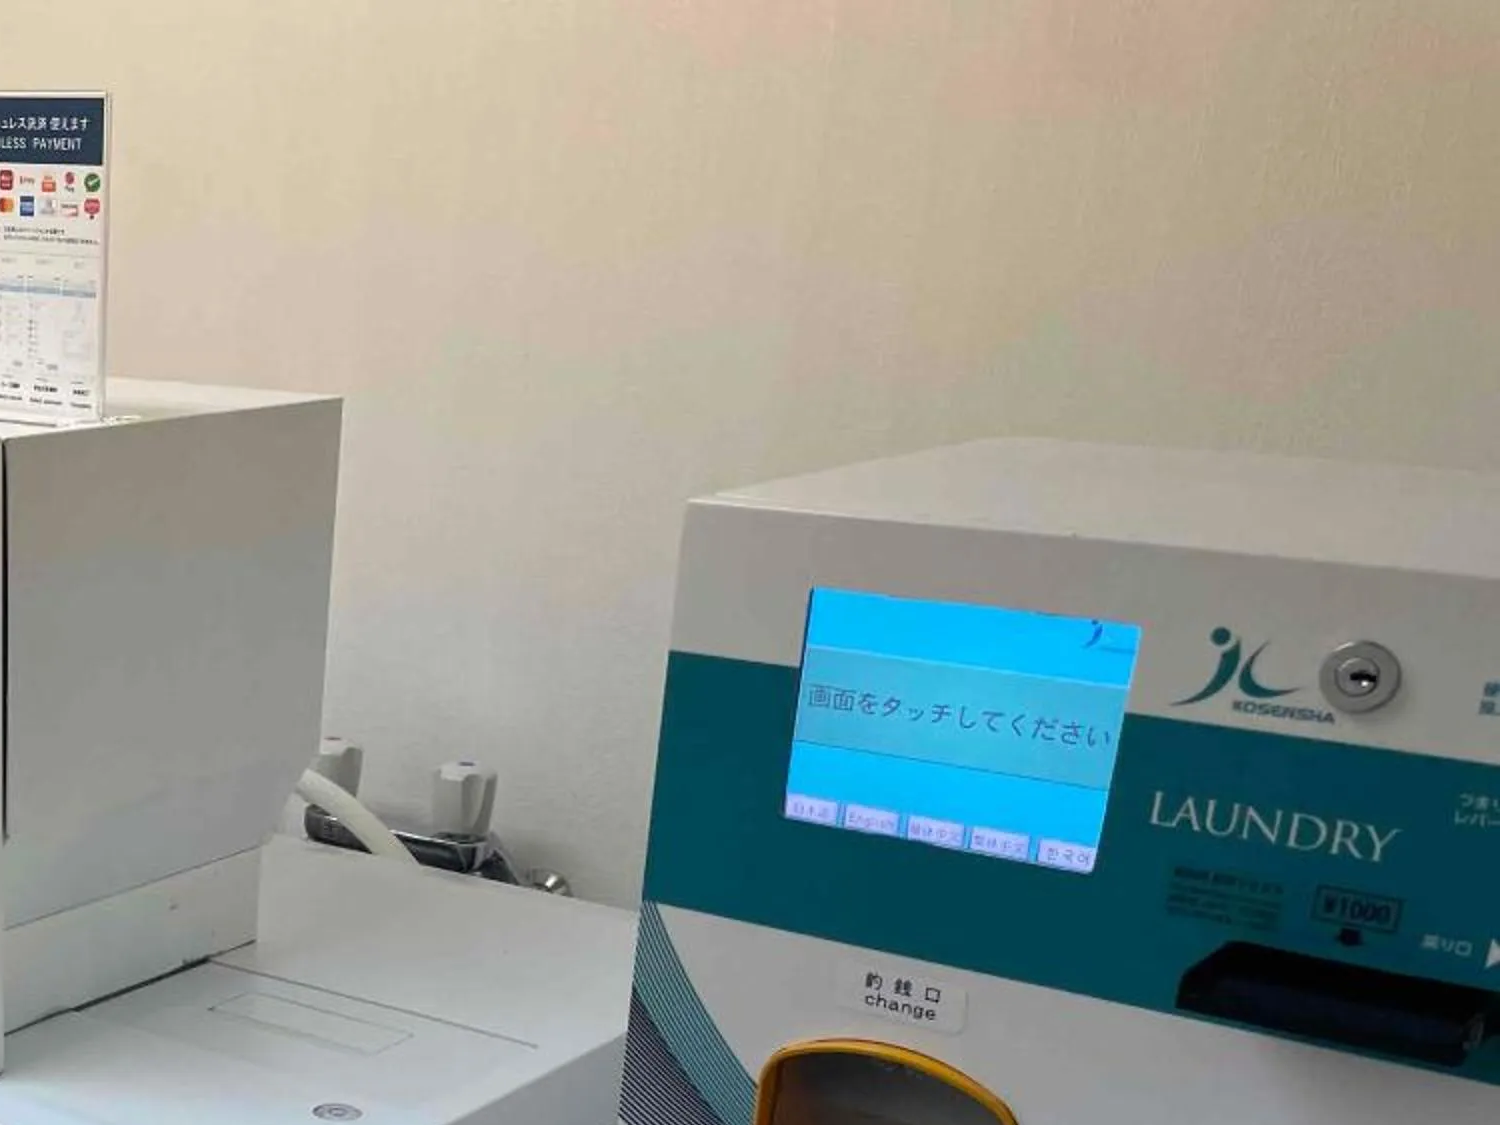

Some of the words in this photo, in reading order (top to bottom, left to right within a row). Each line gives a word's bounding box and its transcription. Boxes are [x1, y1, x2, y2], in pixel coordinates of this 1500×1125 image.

[32, 137, 82, 151] PAYMENT
[807, 683, 1111, 749] 画面をタッチしてください
[1231, 700, 1336, 726] KOSENSHA
[1148, 790, 1404, 863] LAUNDRY
[864, 971, 941, 1004] 釣銭口
[864, 992, 937, 1021] change
